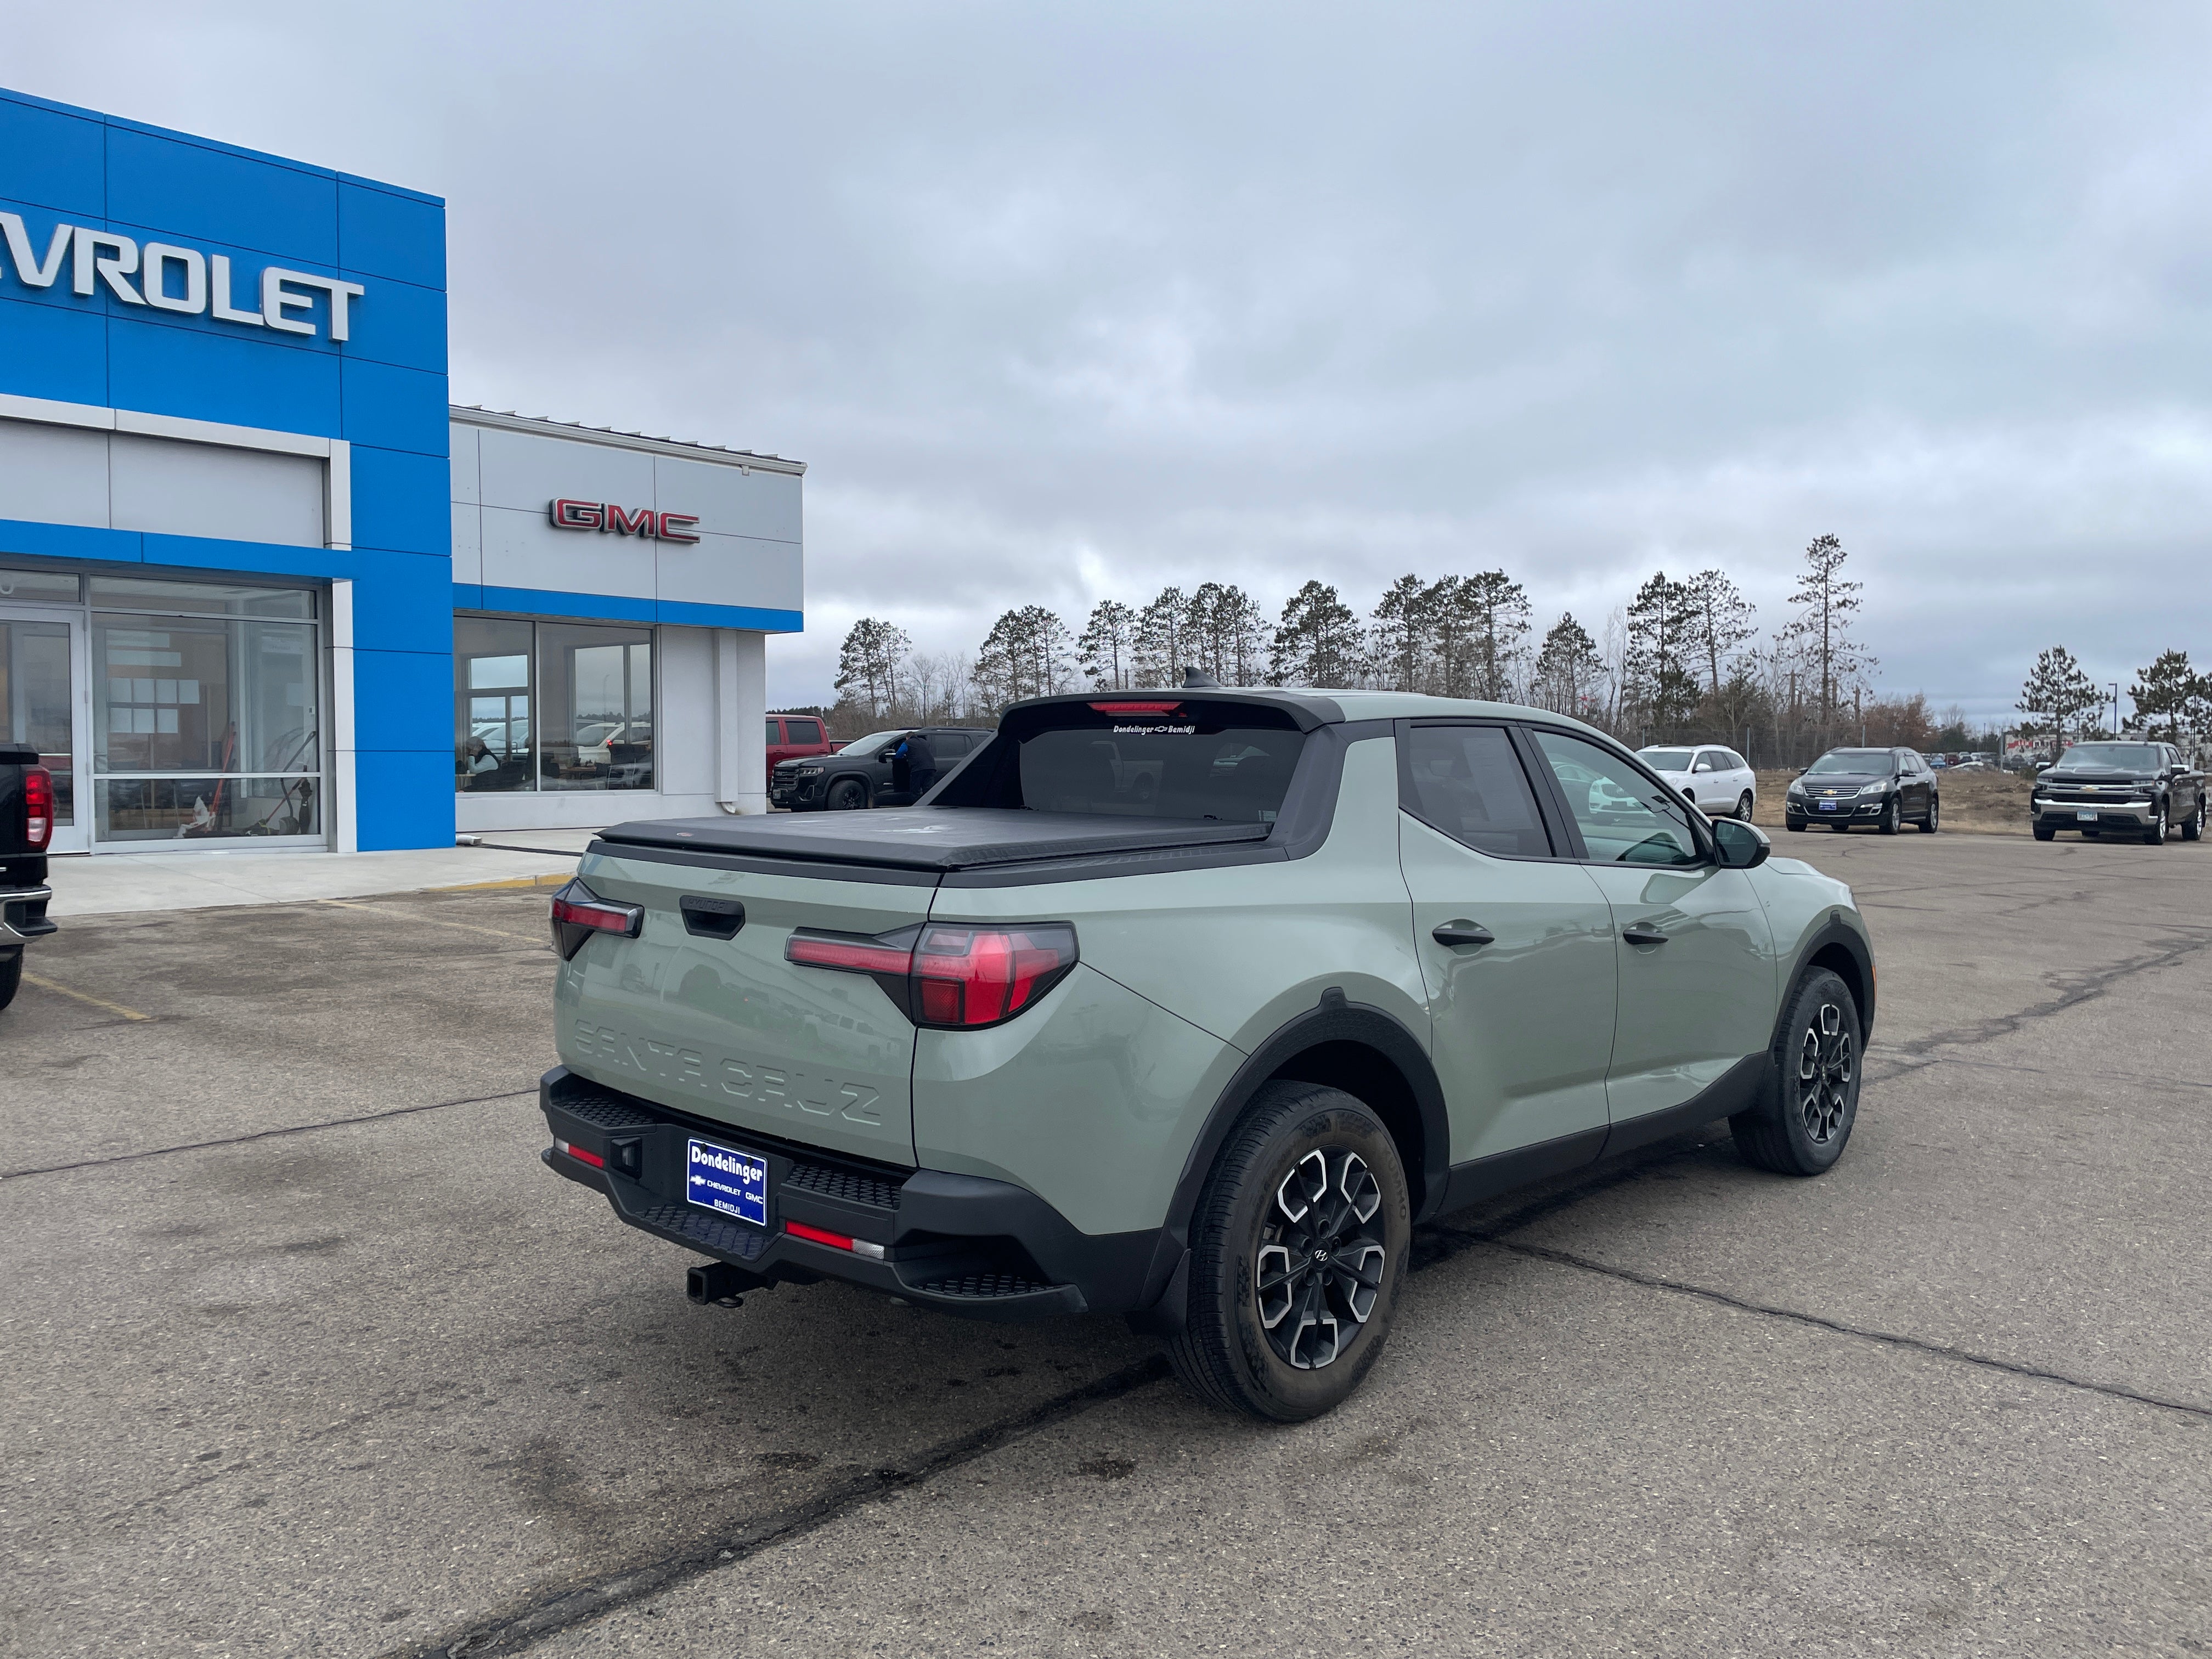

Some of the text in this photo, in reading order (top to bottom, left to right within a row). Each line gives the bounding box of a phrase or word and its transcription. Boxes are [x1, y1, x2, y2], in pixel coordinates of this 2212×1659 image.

[0, 211, 365, 342] VROLET
[550, 497, 700, 543] GMC
[1113, 725, 1195, 735] Dondelinger Bemidji
[575, 1019, 881, 1126] SANTA CRUZ
[691, 1145, 763, 1184] Dondelinger
[707, 1180, 763, 1205] CHEVROLET GMC
[714, 1199, 740, 1214] BEMIDJI
